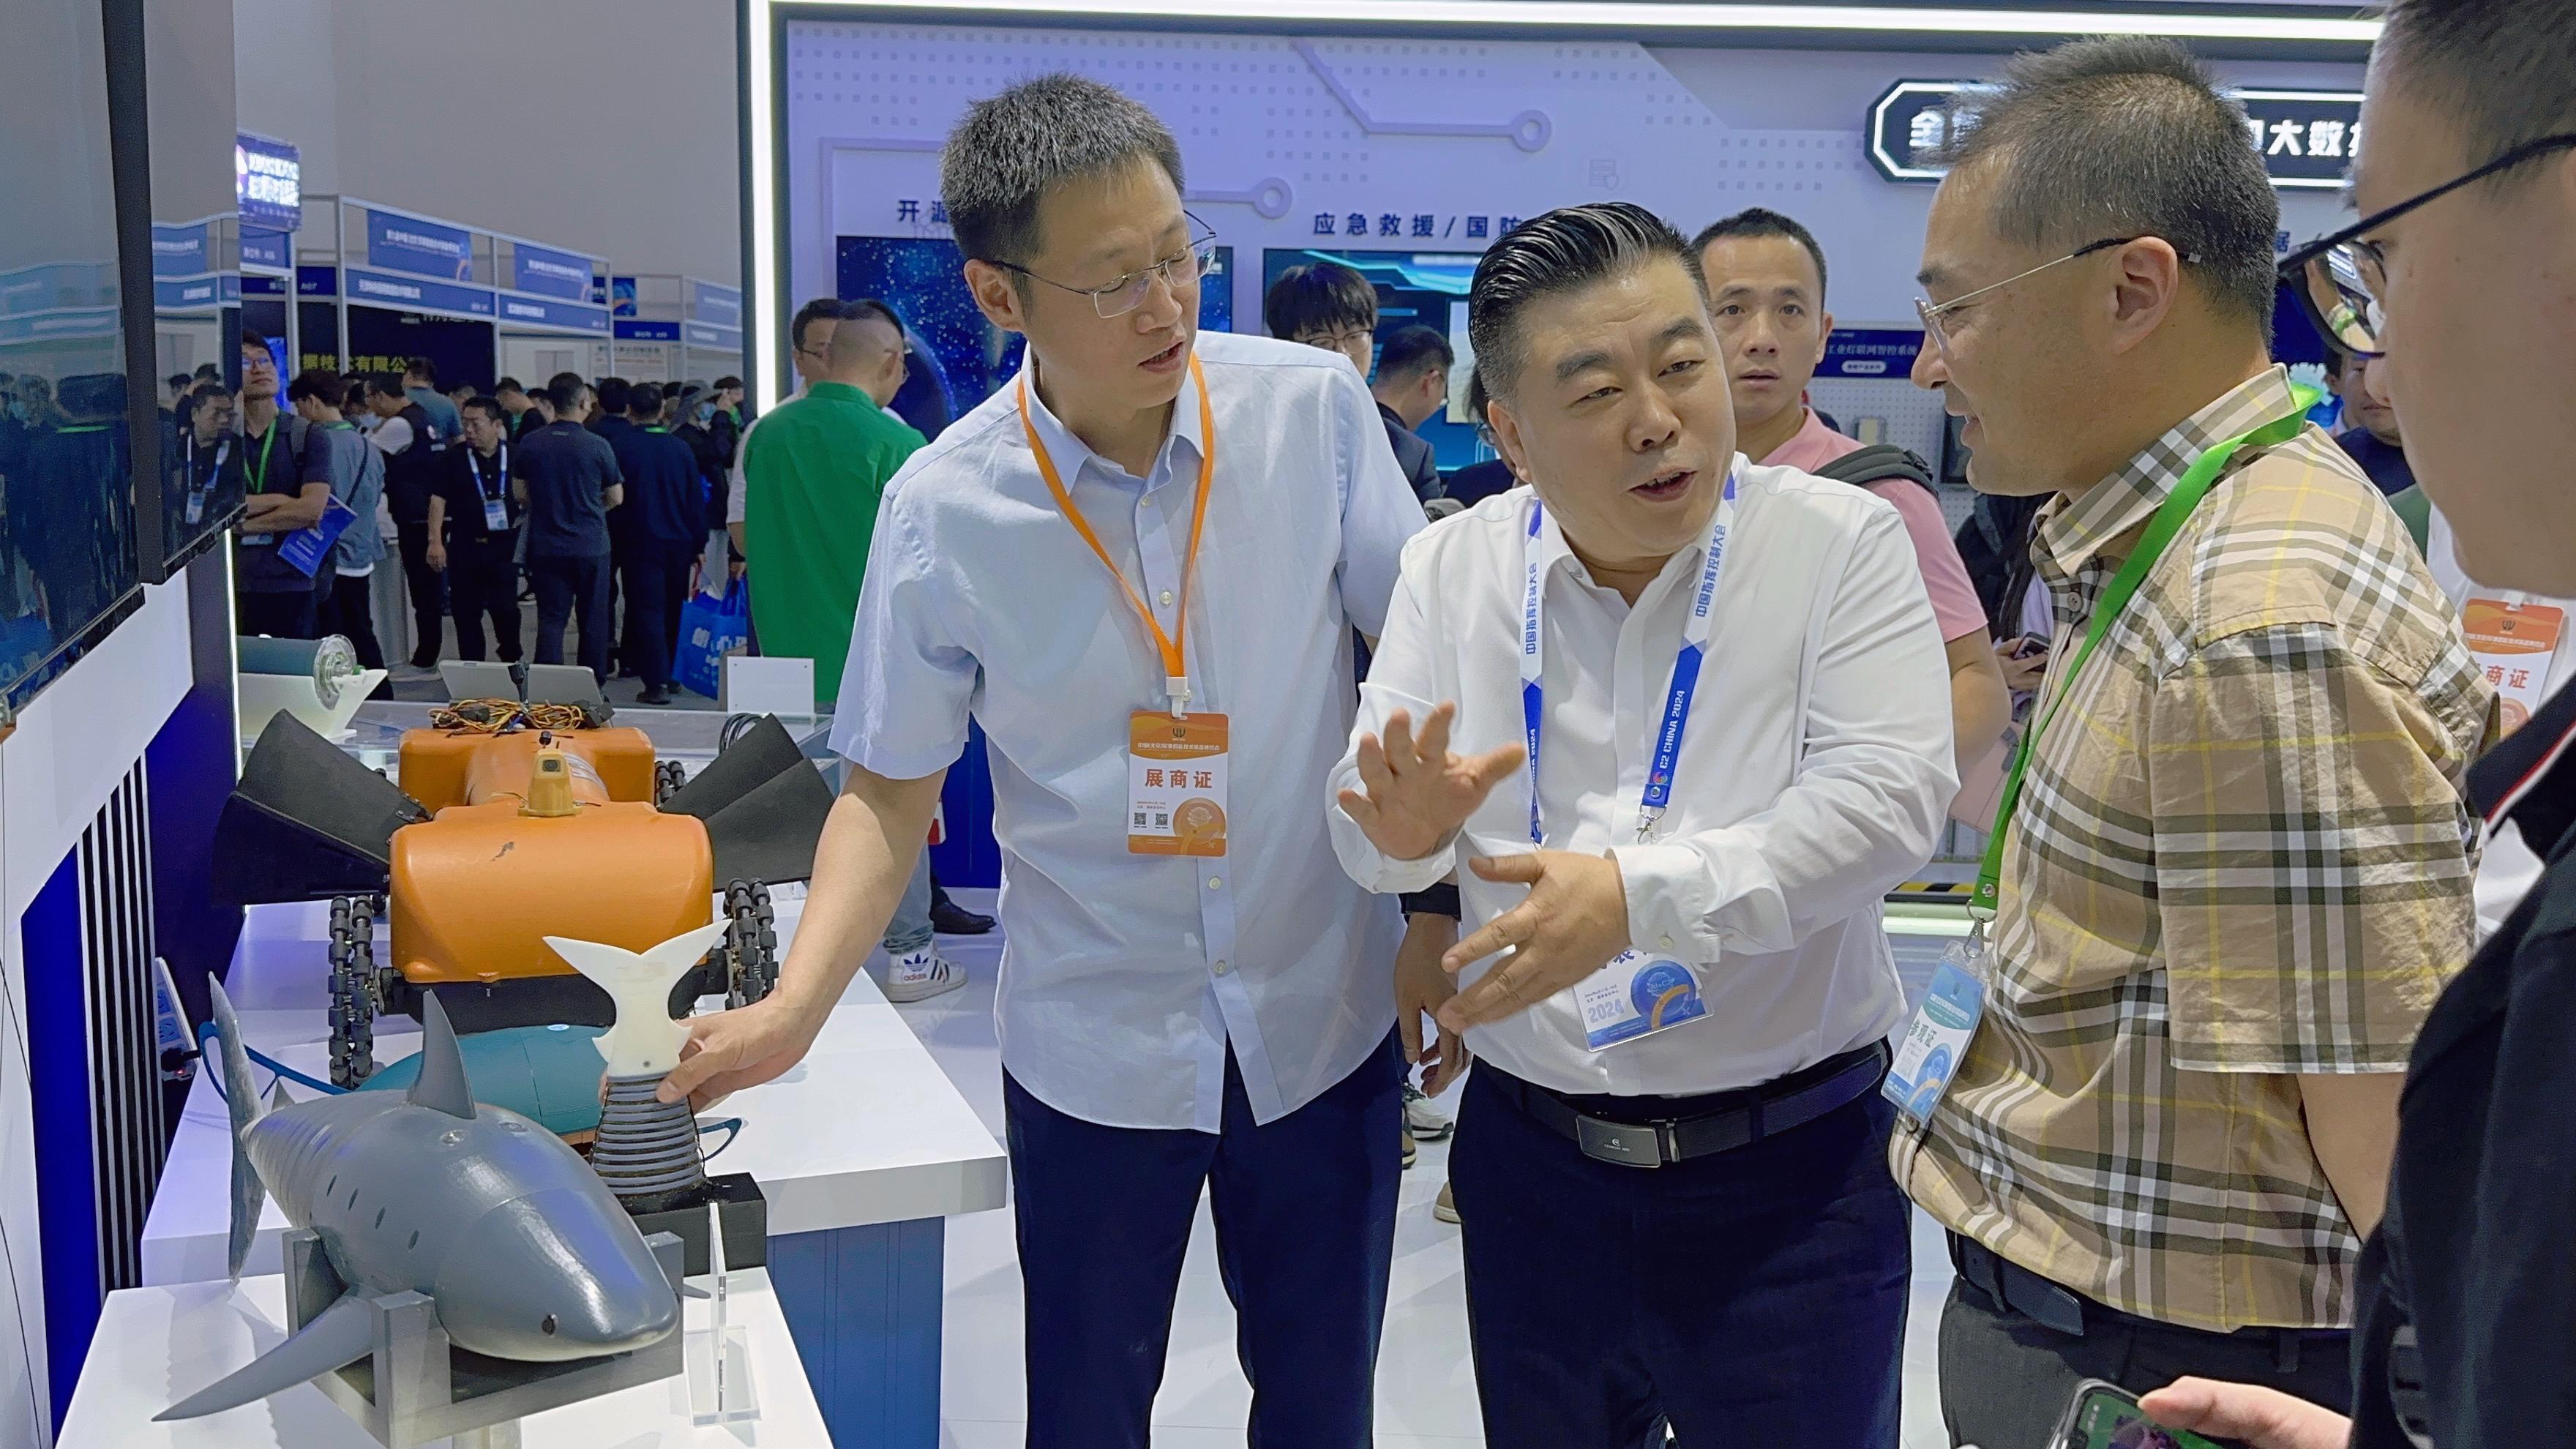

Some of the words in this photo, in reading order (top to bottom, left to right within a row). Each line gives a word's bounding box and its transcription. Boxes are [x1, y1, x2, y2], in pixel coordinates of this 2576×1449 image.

[1695, 524, 1726, 618] 中国指挥控制大会
[2485, 664, 2530, 689] 商证
[1671, 690, 1685, 718] 2024
[1663, 720, 1678, 753] CHINA
[1659, 755, 1670, 770] C2
[1145, 768, 1213, 790] 展商证
[1587, 998, 1625, 1024] 2024
